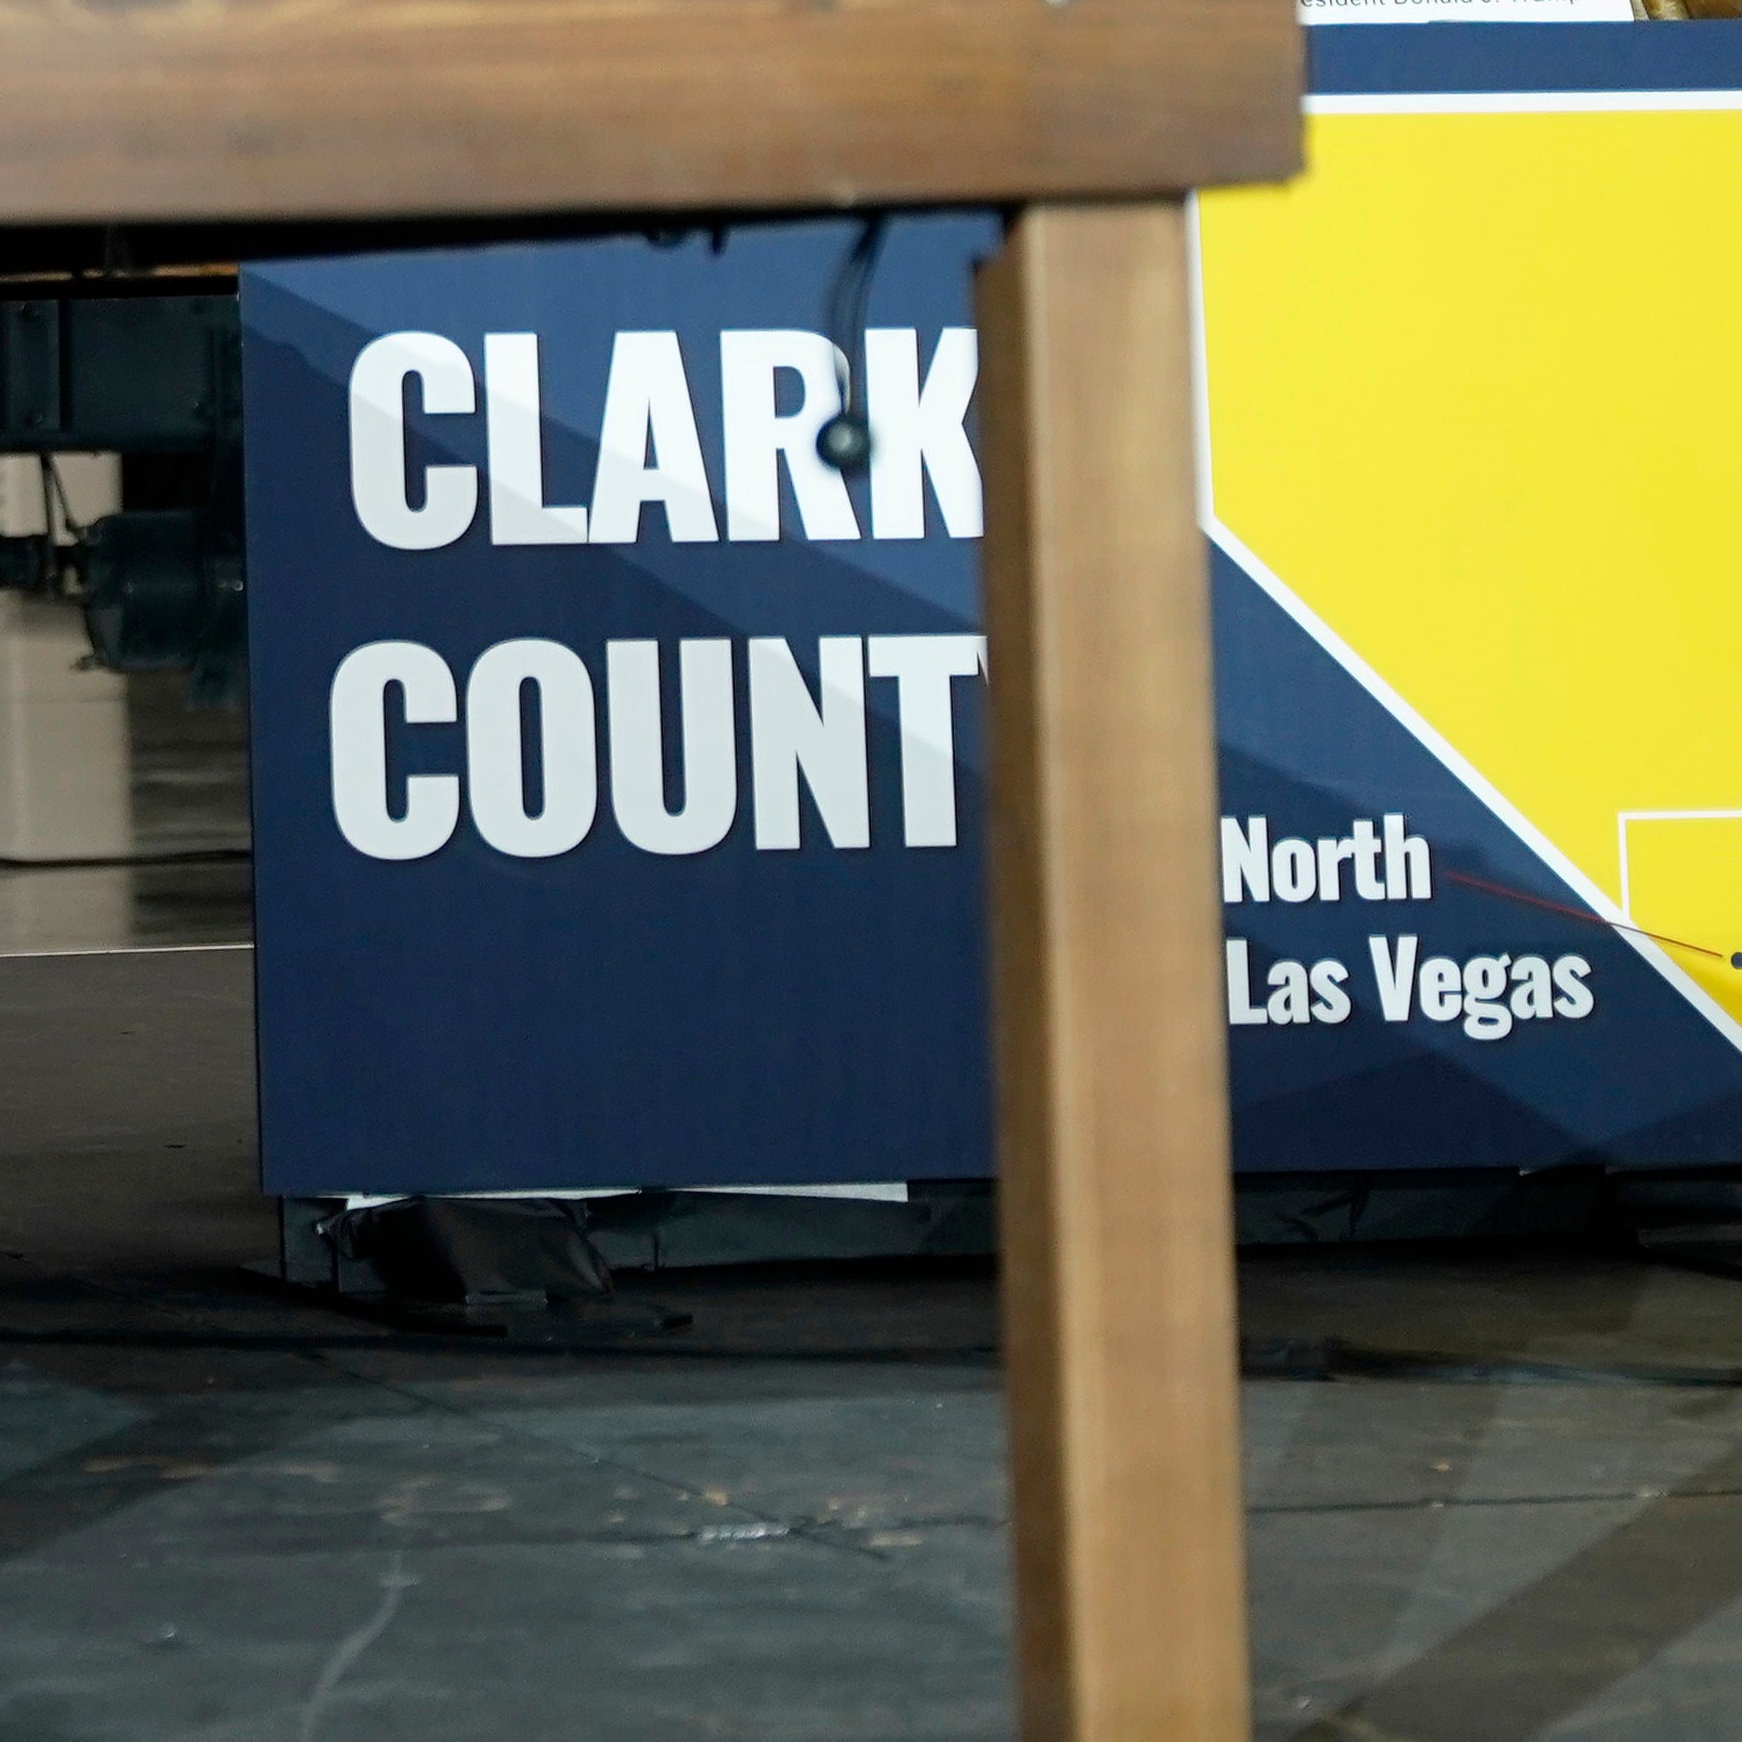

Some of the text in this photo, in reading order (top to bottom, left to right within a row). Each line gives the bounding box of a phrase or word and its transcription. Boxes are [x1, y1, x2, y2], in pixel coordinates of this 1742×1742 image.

[349, 326, 983, 551] CLARK
[329, 633, 990, 860] COUNT
[1220, 811, 1432, 903] North
[1226, 934, 1595, 1041] Las Vegas
